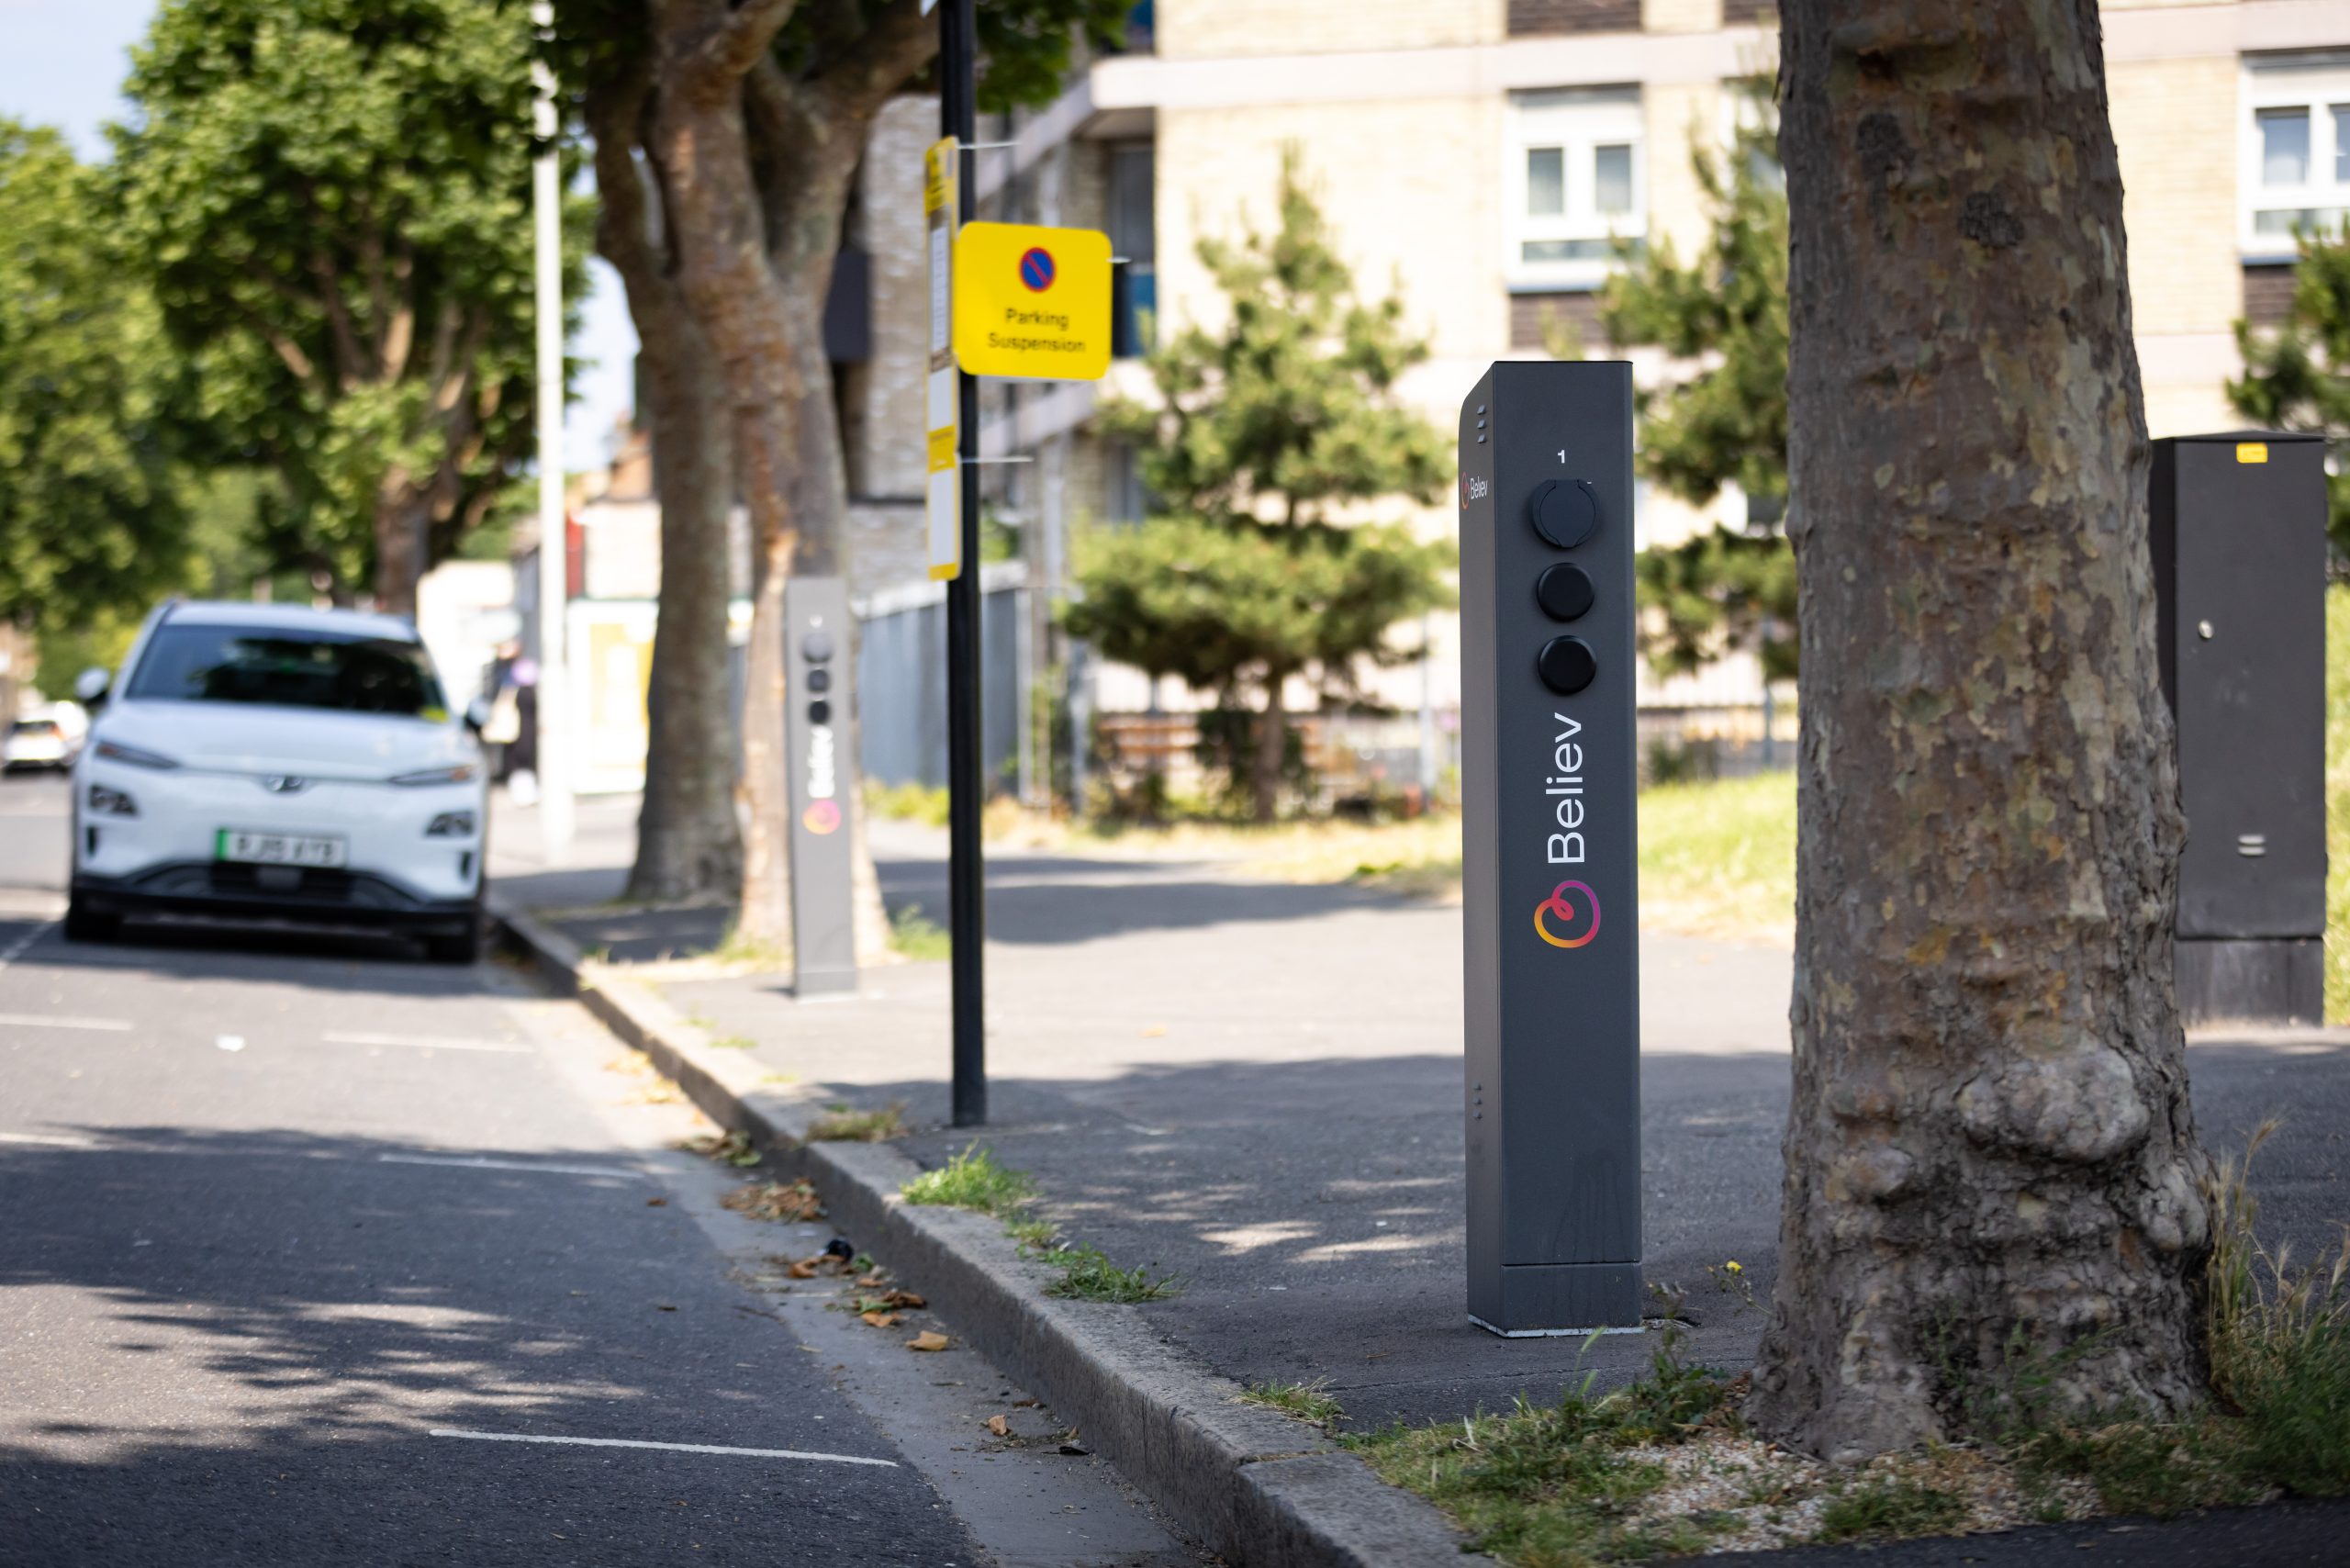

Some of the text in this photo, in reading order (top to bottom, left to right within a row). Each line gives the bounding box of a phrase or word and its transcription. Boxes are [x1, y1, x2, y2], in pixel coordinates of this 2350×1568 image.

[1004, 308, 1069, 331] Parking
[988, 331, 1086, 353] Suspension
[1557, 449, 1566, 464] 1
[1470, 476, 1488, 500] Believ
[1545, 711, 1585, 864] Believ
